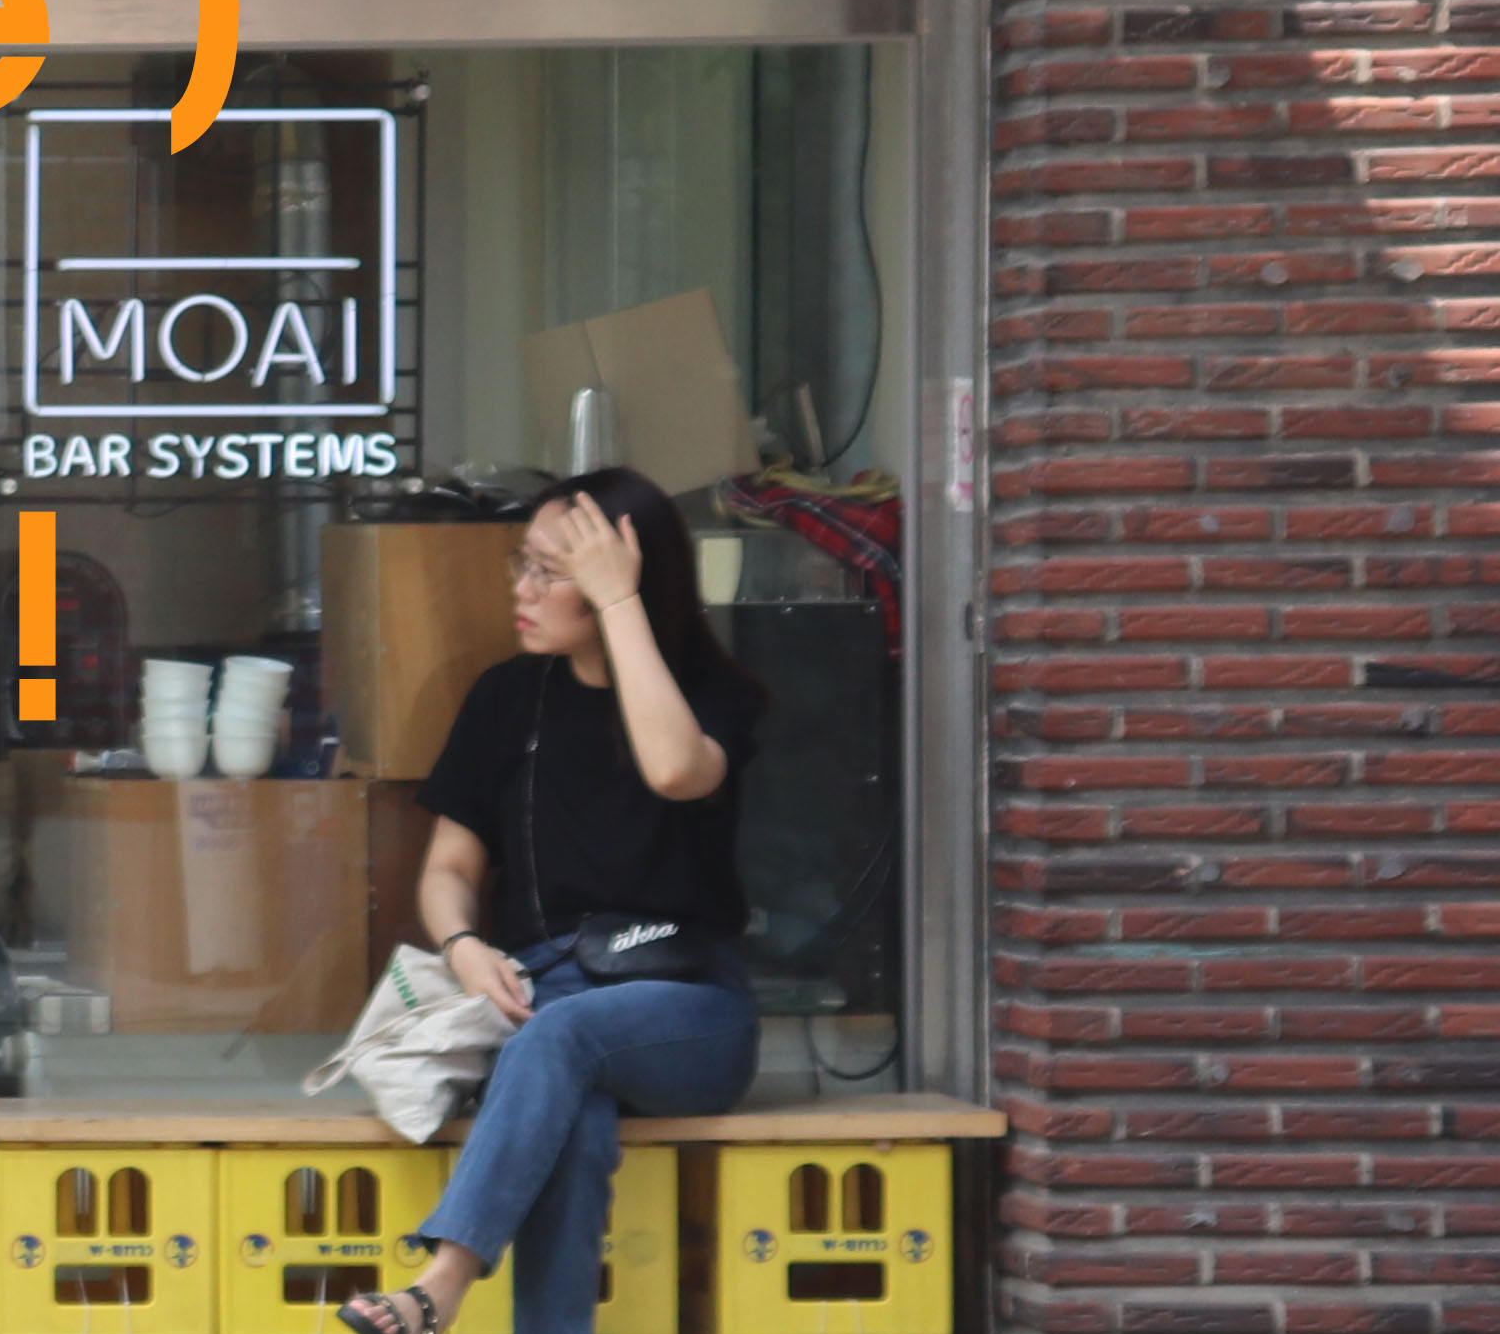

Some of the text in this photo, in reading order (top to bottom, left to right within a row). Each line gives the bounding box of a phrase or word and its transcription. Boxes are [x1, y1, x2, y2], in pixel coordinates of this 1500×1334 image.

[60, 293, 357, 388] MOAI
[24, 433, 132, 478] BAR
[146, 433, 398, 479] SYSTEMS
